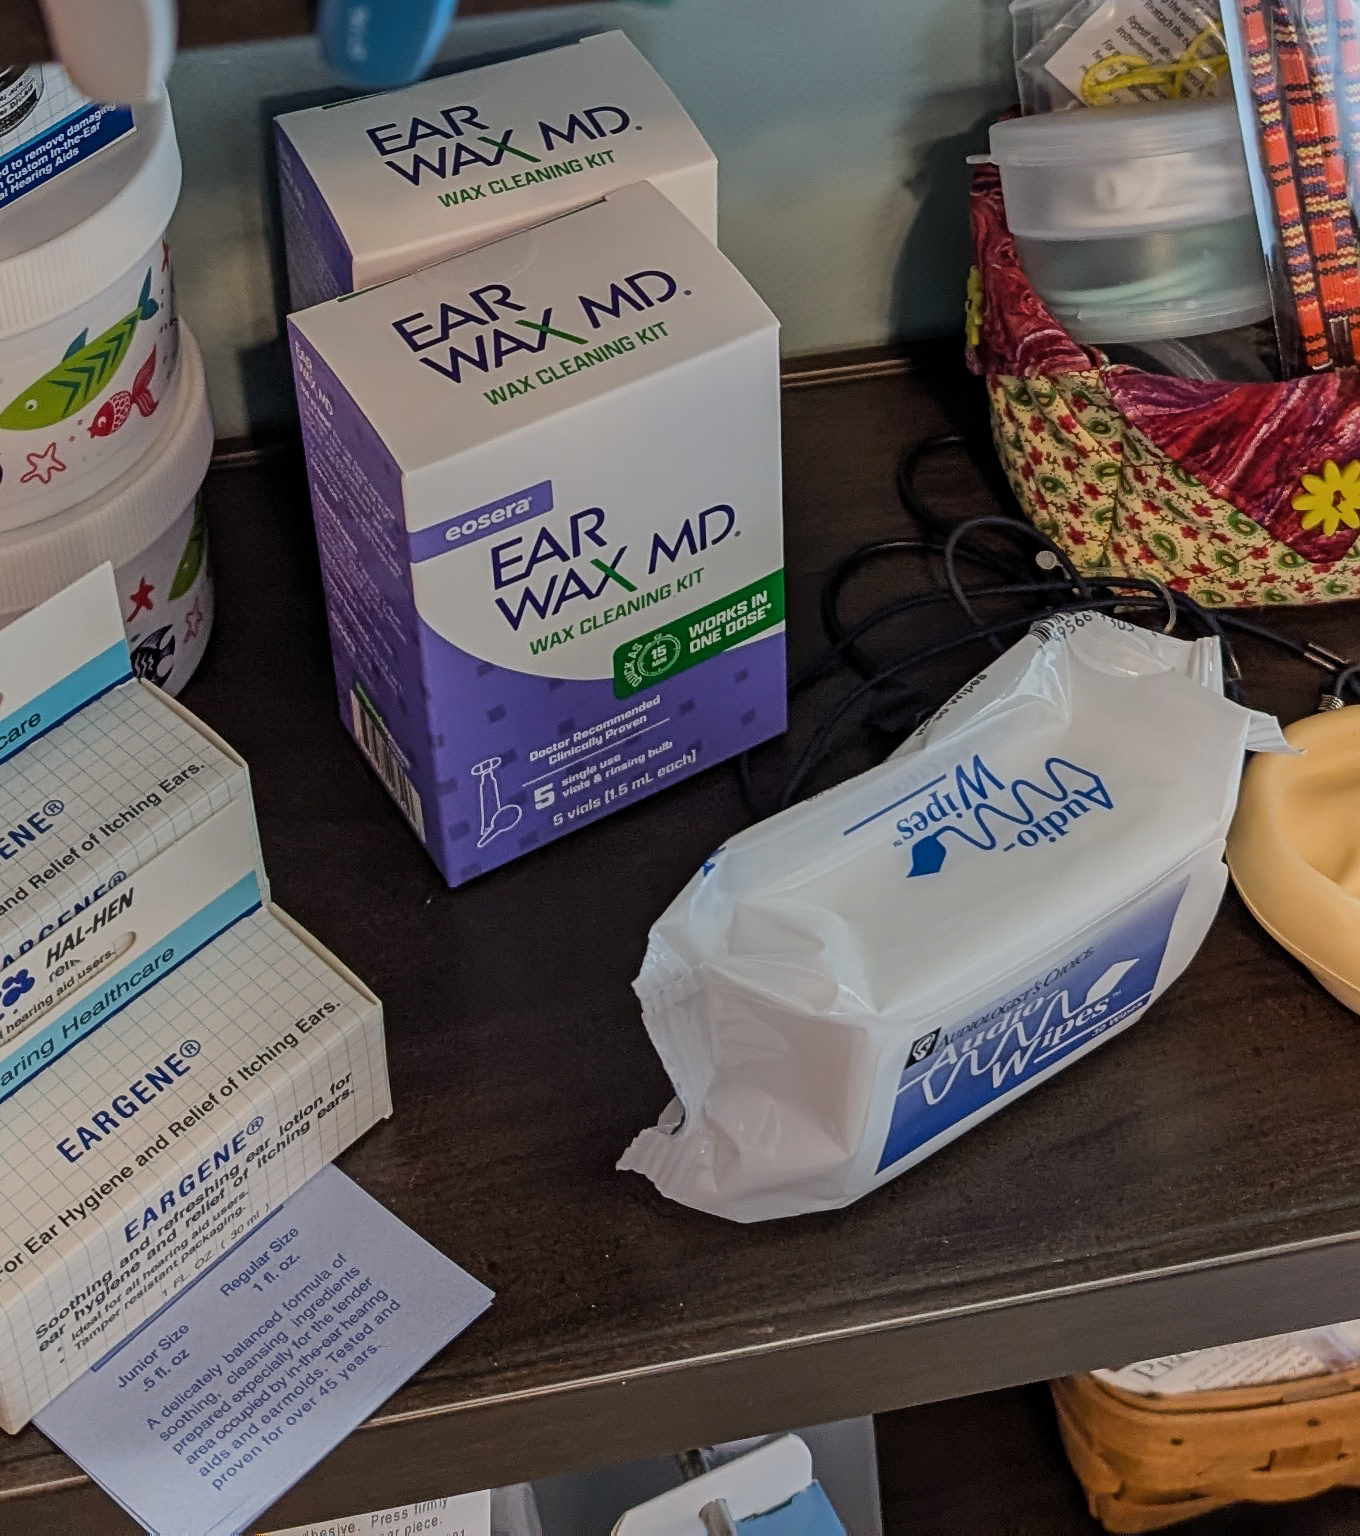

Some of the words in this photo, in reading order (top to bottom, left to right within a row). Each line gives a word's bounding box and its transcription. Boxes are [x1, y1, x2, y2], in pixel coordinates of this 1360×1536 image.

[6, 157, 49, 184] Custom
[51, 121, 101, 160] In-the-Ear
[11, 159, 23, 171] to
[25, 134, 65, 160] remove
[66, 103, 117, 137] damaging
[366, 104, 490, 156] EAR
[385, 129, 541, 187] WAX
[11, 165, 53, 195] Hearing
[55, 148, 80, 167] Aids
[437, 184, 487, 210] WAX
[490, 157, 585, 197] CLEANING
[587, 149, 616, 170] KIT
[391, 283, 527, 352] EAR
[419, 307, 589, 385] WAX
[483, 375, 537, 407] WAX
[535, 332, 635, 387] CLEANING
[636, 321, 670, 350] KIT
[445, 496, 532, 543] eosera
[490, 507, 609, 590] EAR
[494, 546, 638, 632] WAX
[529, 625, 575, 656] WAX
[579, 584, 672, 637] CLEANING
[676, 567, 706, 592] KIT
[688, 598, 749, 639] WORKS
[751, 590, 768, 609] IN
[689, 630, 722, 654] ONE
[529, 736, 571, 762] Doctor
[572, 694, 662, 742] Recommended
[548, 735, 604, 765] Clinically
[605, 714, 648, 740] Proven
[533, 782, 556, 811] 5
[561, 779, 590, 798] vials
[605, 754, 646, 779] rinsing
[647, 740, 674, 758] bulb
[561, 765, 597, 788] single
[599, 753, 621, 769] use
[895, 753, 1008, 843] Wipes
[28, 846, 83, 891] Relief
[98, 792, 163, 838] Itching
[158, 762, 206, 794] Ears.
[567, 797, 602, 821] vials
[45, 887, 135, 969] HAL-HEN
[61, 945, 176, 1040] Healthcare
[992, 997, 1110, 1089] Wipes
[23, 1223, 59, 1255] Ear
[57, 1166, 135, 1228] Hygiene
[134, 1134, 171, 1167] and
[167, 1091, 220, 1138] Relief
[236, 1034, 300, 1083] Itching
[294, 998, 341, 1034] Ears.
[35, 1269, 113, 1340] Soothing
[119, 1236, 151, 1270] and
[157, 1163, 241, 1238] refreshing
[278, 1095, 324, 1136] lotion
[73, 1262, 141, 1324] hygiene
[146, 1228, 178, 1261] and
[184, 1187, 226, 1229] relief
[256, 1119, 312, 1169] itching
[142, 1237, 189, 1280] hearing
[219, 1250, 271, 1297] Regular
[268, 1226, 300, 1253] Size
[117, 1348, 158, 1390] Junior
[158, 1323, 190, 1351] Size
[159, 1390, 222, 1442] soothing,
[226, 1330, 290, 1386] cleansing
[292, 1265, 362, 1329] ingredients
[160, 1363, 224, 1418] delicately
[222, 1310, 284, 1365] balanced
[281, 1267, 334, 1313] formula
[172, 1400, 232, 1456] prepared
[331, 1275, 375, 1314] tender
[215, 1389, 272, 1441] occupied
[341, 1288, 390, 1332] hearing
[198, 1448, 232, 1478] aids
[261, 1367, 330, 1425] earmolds.
[325, 1322, 375, 1365] Tested
[373, 1299, 402, 1327] and
[210, 1443, 264, 1492] proven
[285, 1396, 318, 1427] over
[371, 1508, 409, 1528] Press
